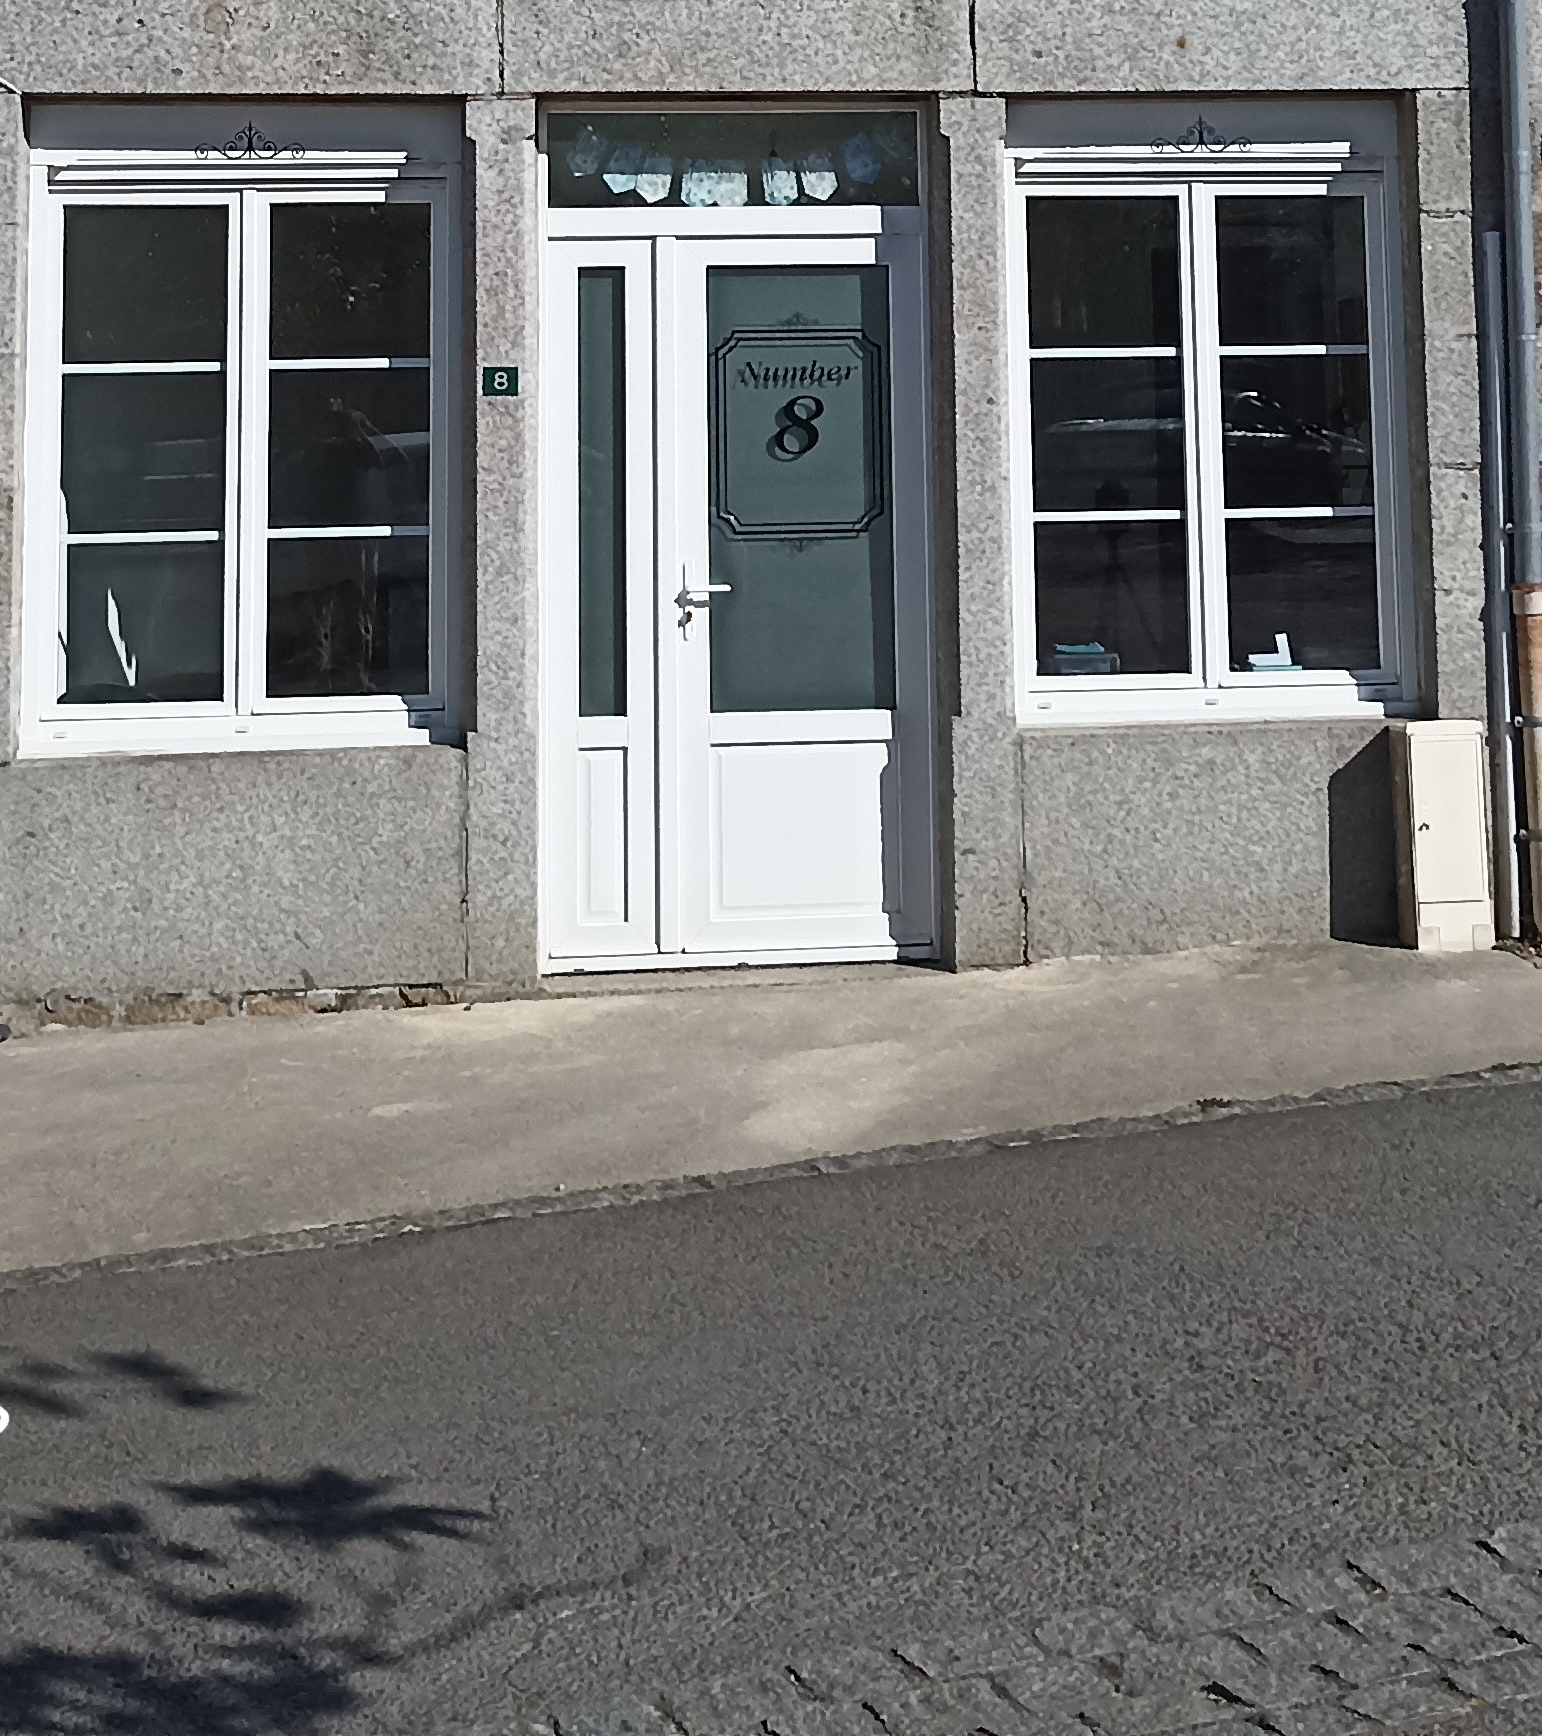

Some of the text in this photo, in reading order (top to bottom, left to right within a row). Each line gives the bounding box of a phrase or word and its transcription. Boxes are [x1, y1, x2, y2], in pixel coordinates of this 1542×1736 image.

[493, 371, 509, 390] 8
[738, 359, 859, 385] Number
[774, 395, 825, 455] 8
